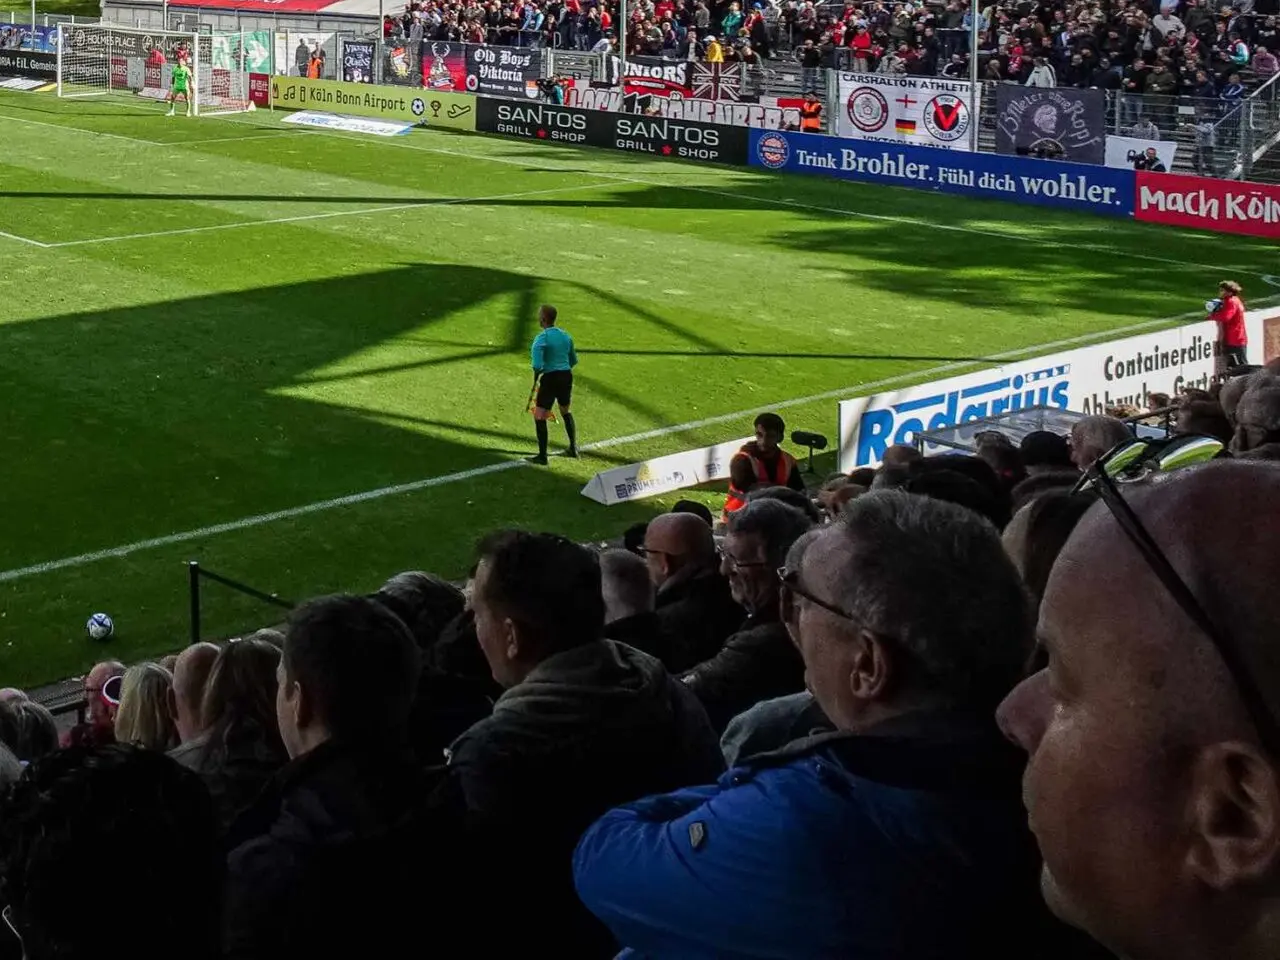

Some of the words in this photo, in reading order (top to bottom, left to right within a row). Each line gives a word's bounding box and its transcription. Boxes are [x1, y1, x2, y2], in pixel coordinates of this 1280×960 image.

[474, 49, 495, 63] Old
[499, 50, 531, 68] Boys
[146, 67, 161, 78] MBS
[479, 64, 523, 81] Viktoria
[843, 73, 917, 88] CARSHALTON
[920, 81, 970, 93] ATHLETI
[310, 87, 333, 102] Köln
[336, 90, 361, 105] Bonn
[364, 93, 406, 112] Airport
[498, 106, 587, 130] SANTOS
[497, 123, 532, 136] GRILL
[551, 130, 586, 142] SHOP
[616, 119, 719, 146] SANTOS
[616, 139, 656, 152] GRILL
[678, 147, 719, 159] SHOP
[796, 149, 837, 170] Trink
[840, 148, 934, 181] Brohler.
[938, 166, 974, 187] Fühl
[978, 173, 1016, 192] dich
[1020, 173, 1121, 206] wohler.
[1140, 186, 1219, 220] Mach
